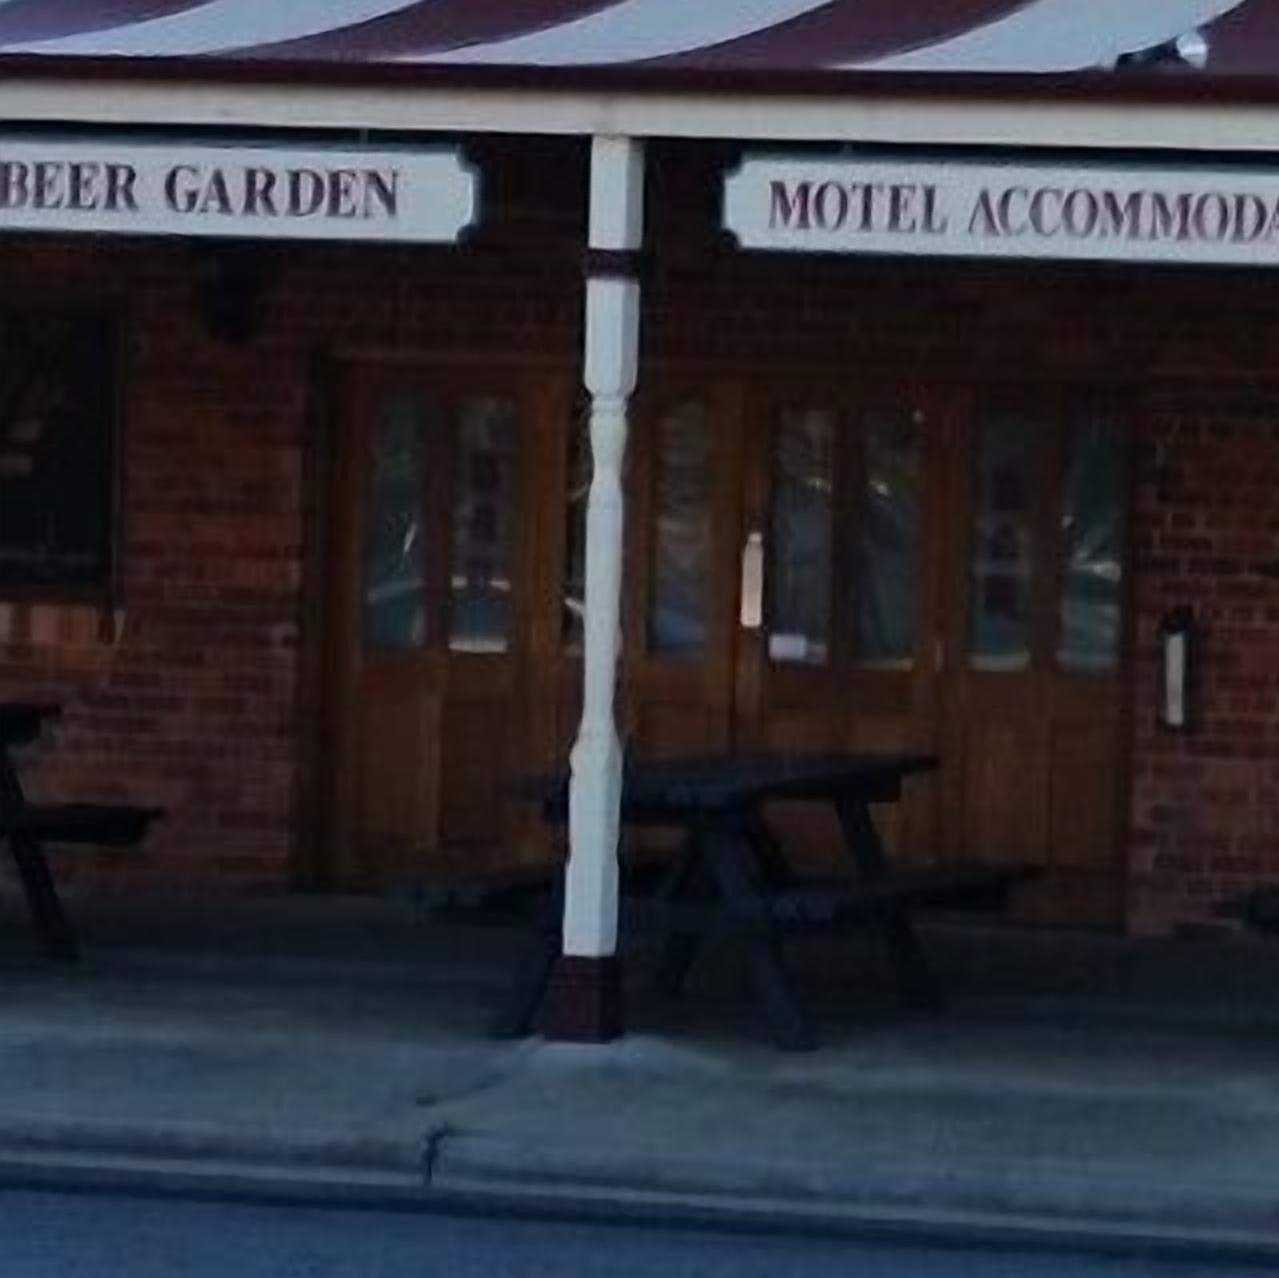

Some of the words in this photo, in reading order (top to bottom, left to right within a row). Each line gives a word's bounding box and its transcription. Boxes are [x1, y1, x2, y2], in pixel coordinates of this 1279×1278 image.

[0, 160, 139, 212] BEER
[165, 163, 399, 219] GARDEN
[767, 180, 948, 234] MOTEL
